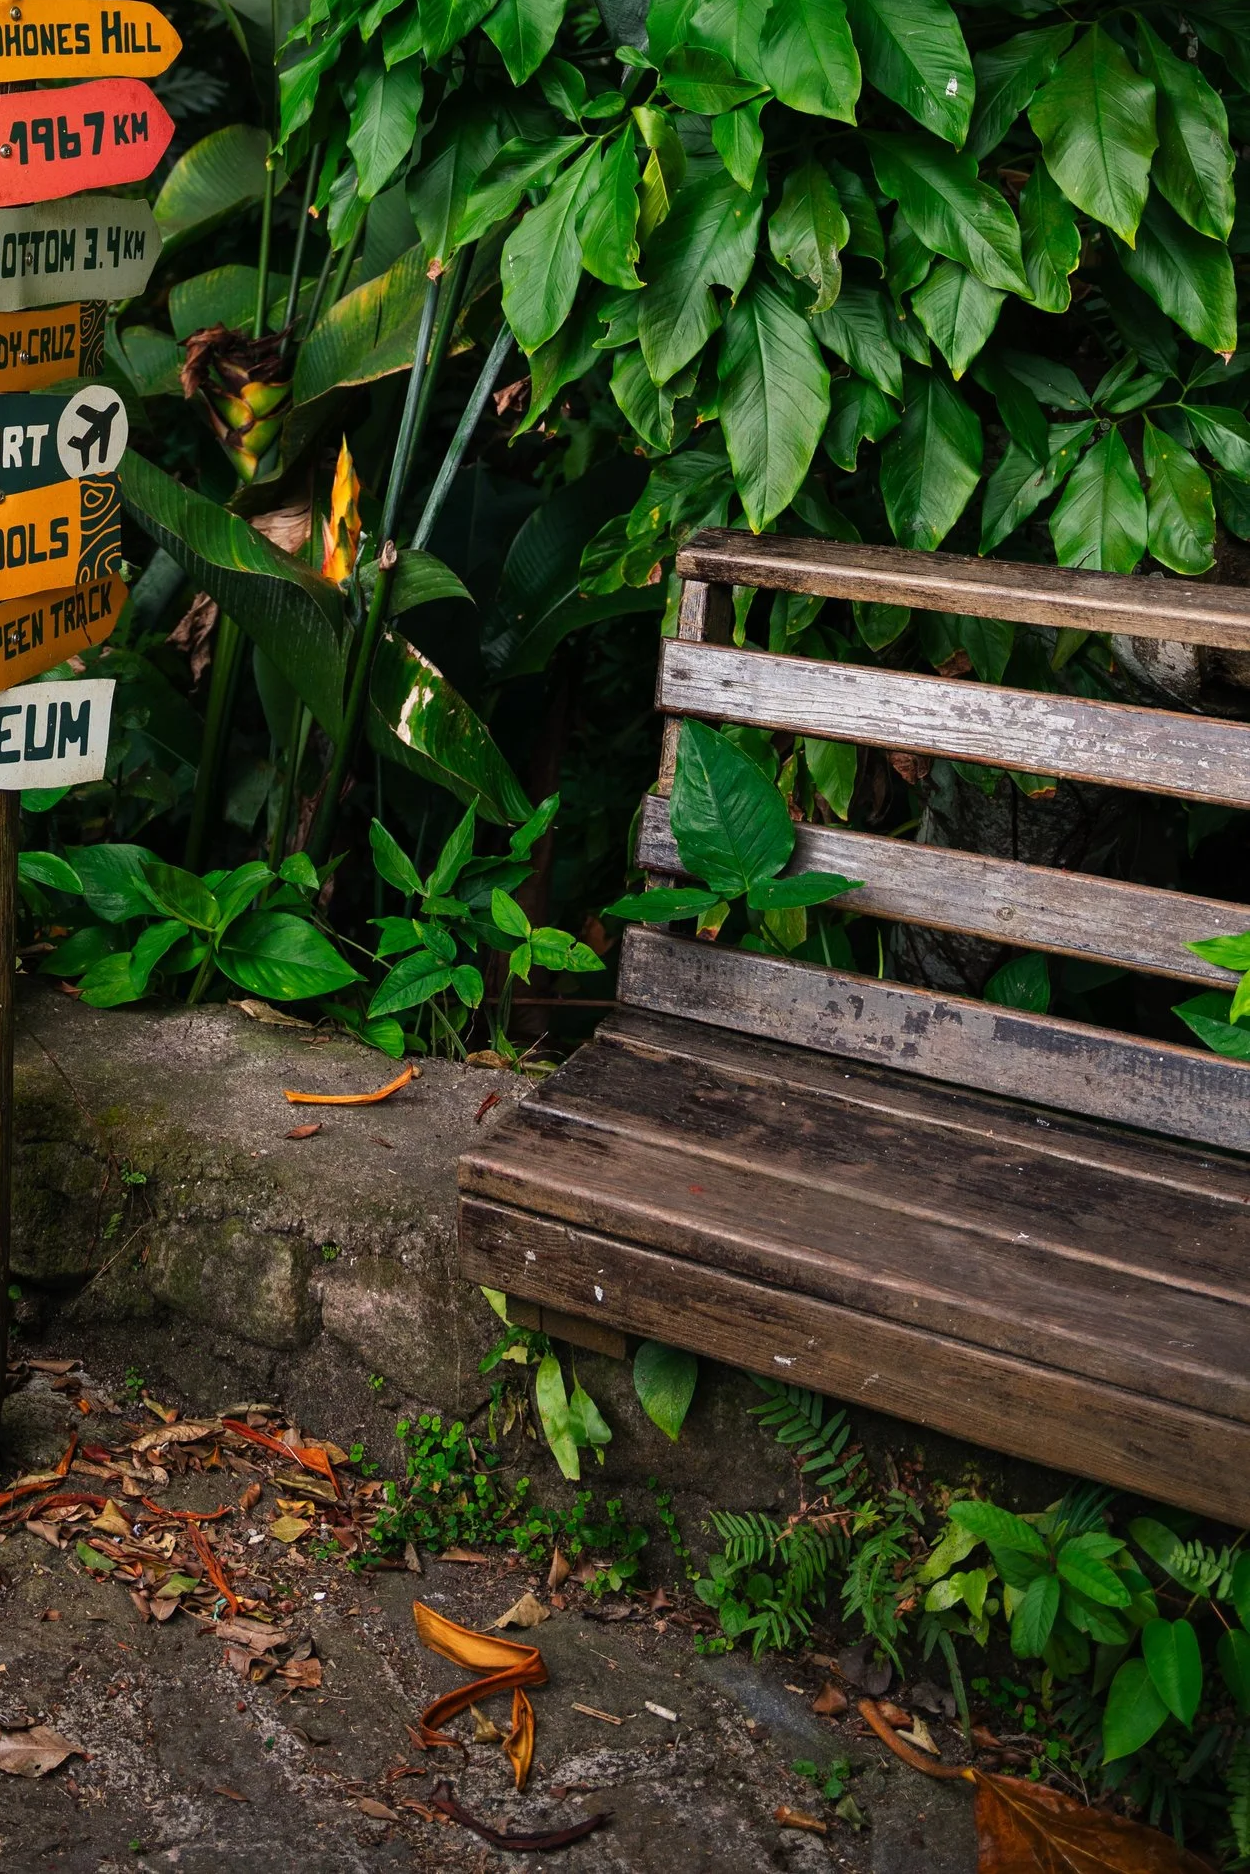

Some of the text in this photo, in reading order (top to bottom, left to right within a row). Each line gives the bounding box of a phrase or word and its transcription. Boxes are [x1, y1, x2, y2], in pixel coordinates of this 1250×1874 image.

[100, 10, 162, 54] HILL
[7, 110, 106, 167] 1967
[113, 111, 149, 147] KM
[83, 224, 122, 271] 3.4
[123, 231, 145, 260] KM
[26, 323, 77, 366] CRUZ
[49, 578, 113, 642] TRACK
